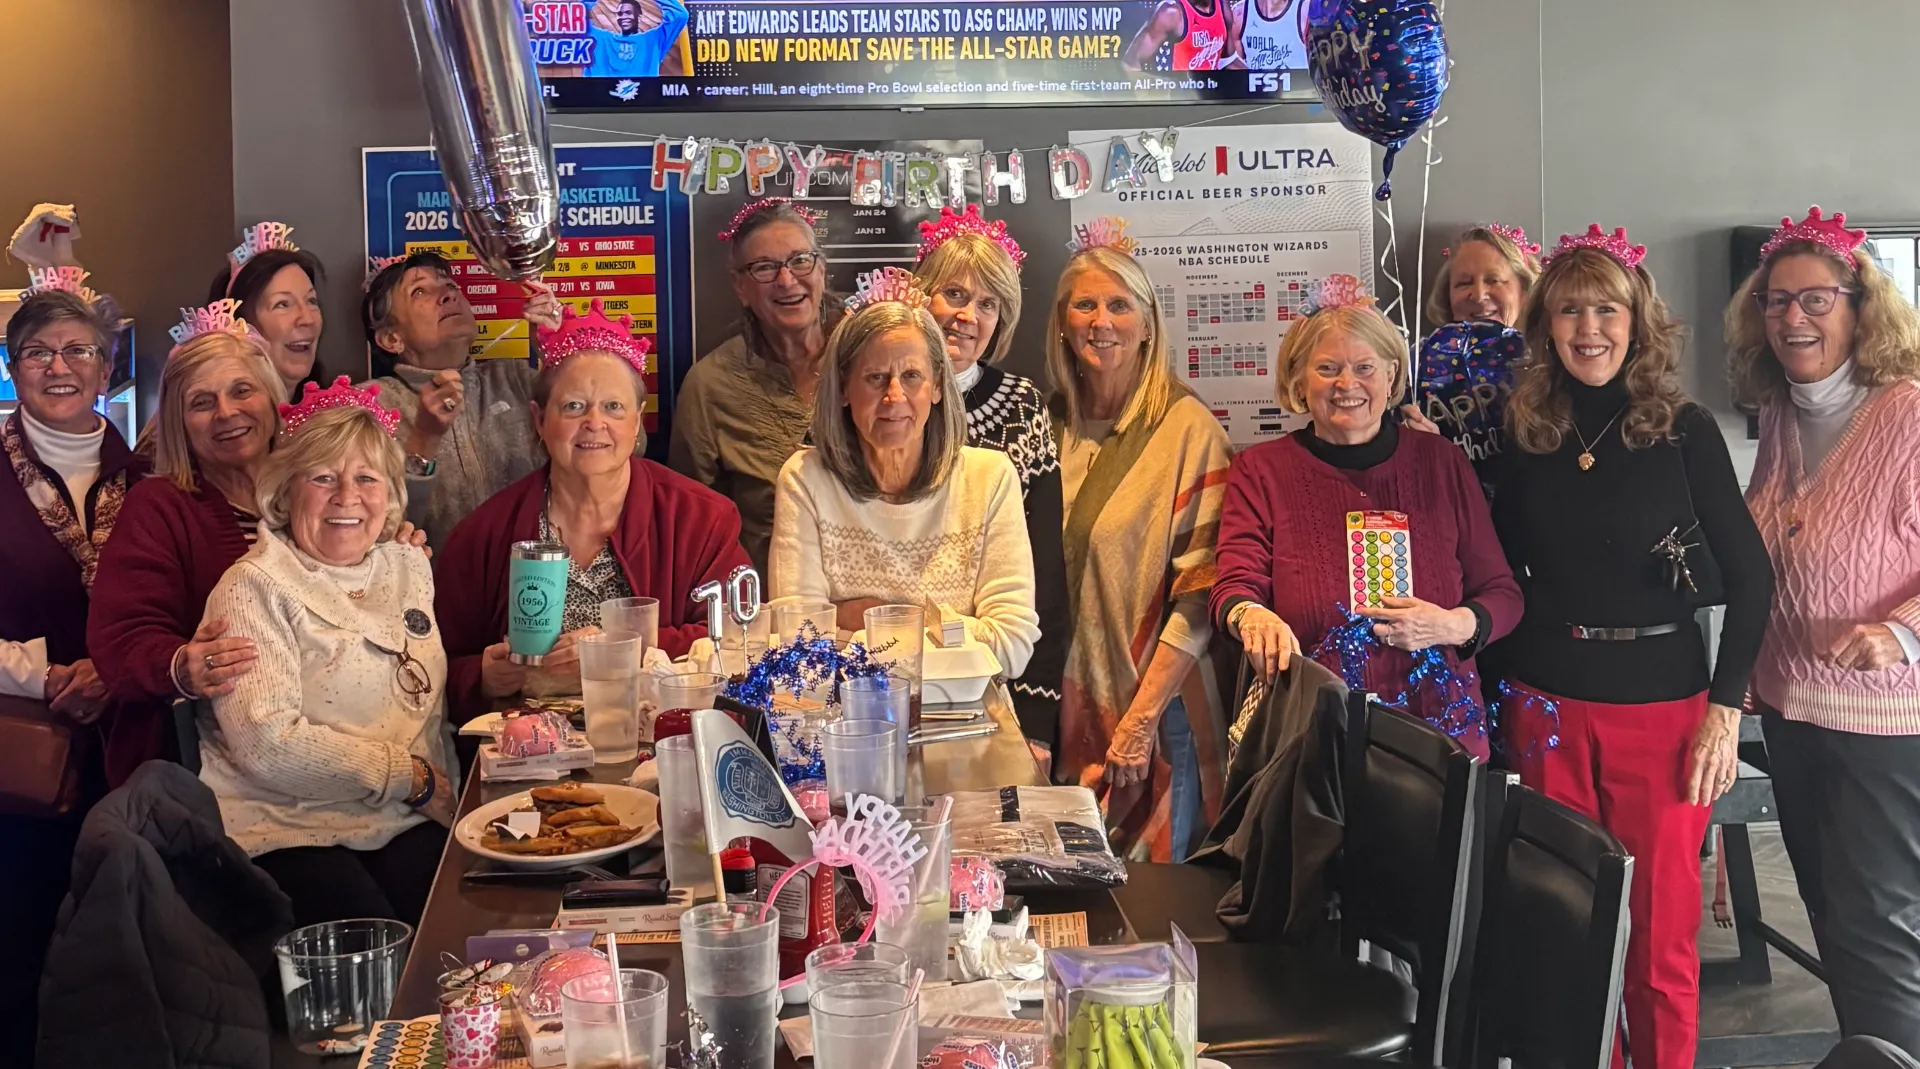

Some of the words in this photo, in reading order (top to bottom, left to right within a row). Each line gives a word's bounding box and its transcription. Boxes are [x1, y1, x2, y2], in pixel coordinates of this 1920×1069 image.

[696, 10, 725, 34] ANT
[729, 10, 799, 34] EDWARDS
[803, 10, 848, 33] LEADS
[852, 9, 890, 33] TEAM
[895, 9, 939, 32] STARS
[943, 9, 960, 32] TO
[964, 9, 992, 32] ASG
[997, 8, 1047, 33] CHAMP,
[1051, 8, 1087, 31] WINS
[1092, 8, 1121, 31] MVP
[697, 39, 729, 62] DID
[736, 39, 778, 62] NEW
[784, 38, 861, 61] FORMAT
[866, 38, 913, 61] SAVE
[919, 37, 954, 60] THE
[960, 36, 1053, 60] ALL-STAR
[1058, 36, 1121, 59] GAME?
[662, 84, 689, 96] MIA
[780, 86, 795, 95] an
[799, 83, 864, 96] eight-time
[868, 83, 889, 94] Pro
[892, 82, 922, 93] Bowl
[926, 81, 982, 93] selection
[986, 81, 1008, 92] and
[1012, 80, 1066, 92] five-time
[1070, 80, 1131, 91] first-team
[1134, 79, 1176, 90] All-Pro
[1179, 79, 1204, 90] who
[1249, 73, 1290, 92] FS1
[543, 85, 559, 97] FL
[1239, 149, 1335, 170] ULTRA
[560, 187, 640, 204] ASKETBALL
[1119, 189, 1194, 202] OFFICIAL
[1203, 187, 1242, 199] BEER
[1251, 185, 1326, 197] SPONSOR
[405, 211, 448, 231] 2026
[567, 206, 655, 226] SCHEDULE
[579, 242, 590, 251] VS
[595, 241, 612, 250] OHIO
[613, 240, 635, 250] STATE
[1134, 246, 1182, 256] 25-2026
[1187, 244, 1269, 255] WASHINGTON
[1274, 241, 1329, 252] WIZARDS
[596, 261, 636, 270] MINNESOTA
[1179, 257, 1204, 266] NBA
[1208, 255, 1270, 265] SCHEDULE
[451, 265, 461, 275] VS
[467, 284, 497, 294] OREGON
[580, 282, 590, 291] VS
[596, 281, 615, 290] IOWA
[180, 298, 243, 323] HAPPY
[471, 305, 497, 314] NDIANA
[522, 597, 543, 606] 1956
[513, 616, 550, 627] VINTAGE
